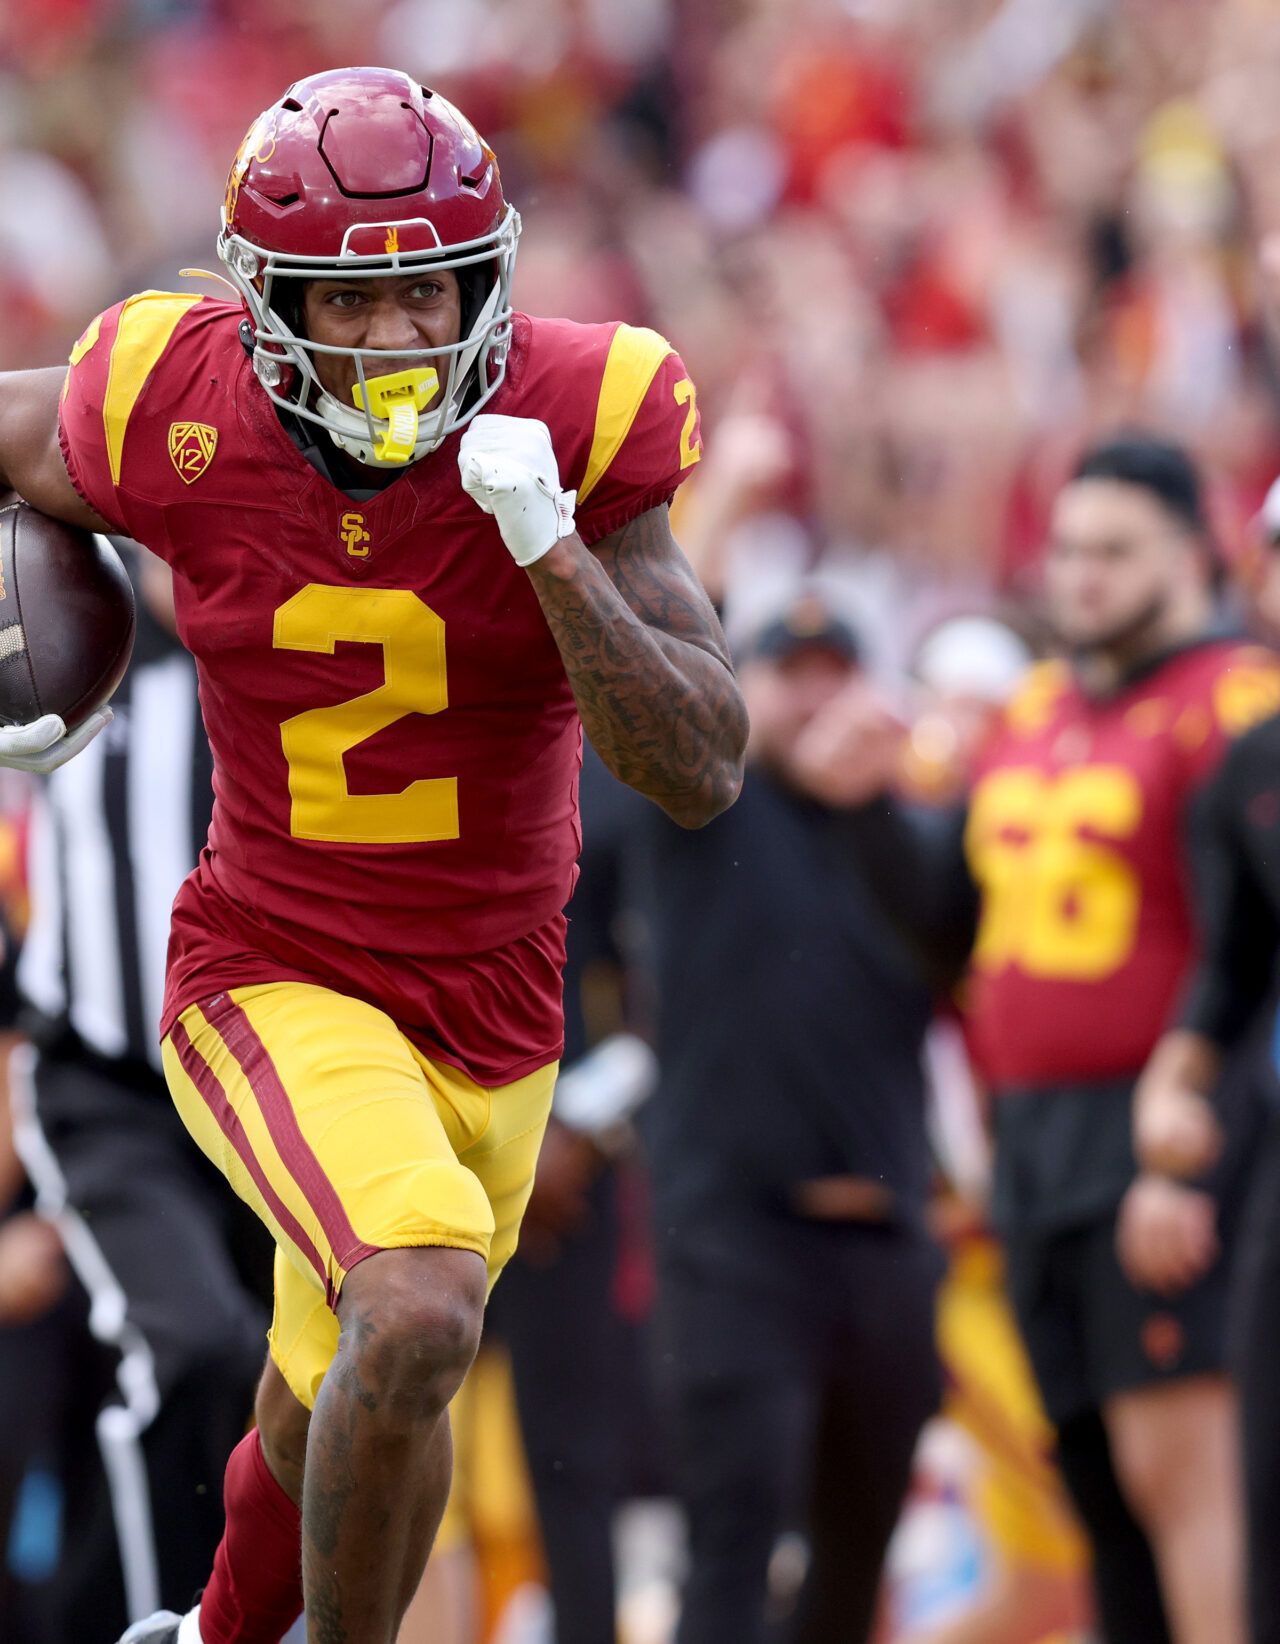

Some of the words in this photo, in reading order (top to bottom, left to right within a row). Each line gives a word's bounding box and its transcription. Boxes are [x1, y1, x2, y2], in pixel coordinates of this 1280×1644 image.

[172, 425, 217, 461] PAC
[674, 379, 701, 470] 2
[179, 449, 202, 471] 12
[341, 514, 371, 557] SC
[273, 584, 459, 842] 2
